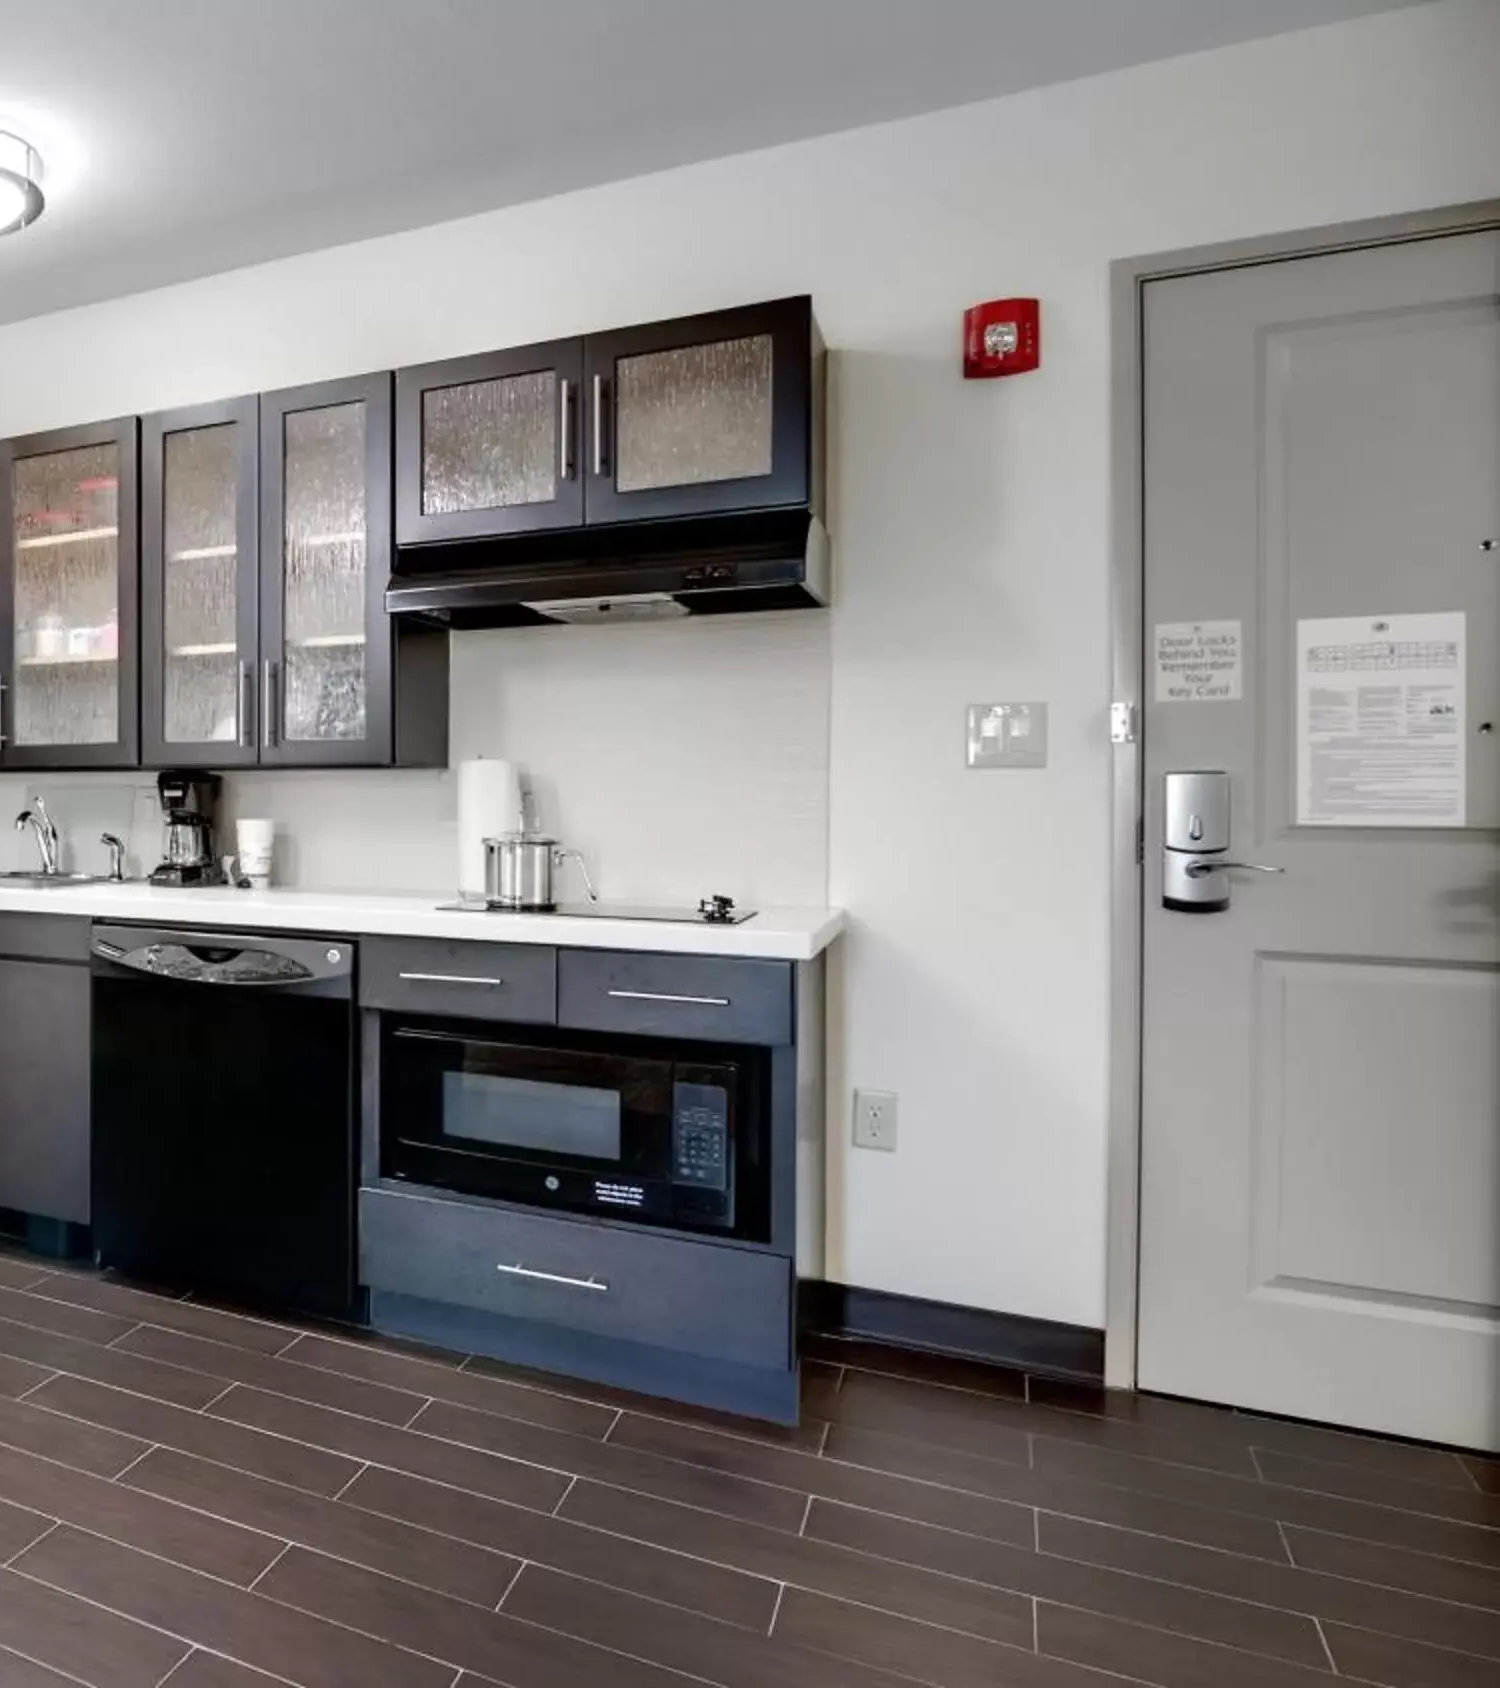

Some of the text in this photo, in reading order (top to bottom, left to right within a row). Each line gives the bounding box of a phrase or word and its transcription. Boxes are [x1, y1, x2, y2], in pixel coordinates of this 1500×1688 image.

[1160, 635, 1237, 647] Door Locks
[1158, 648, 1205, 660] Behind
